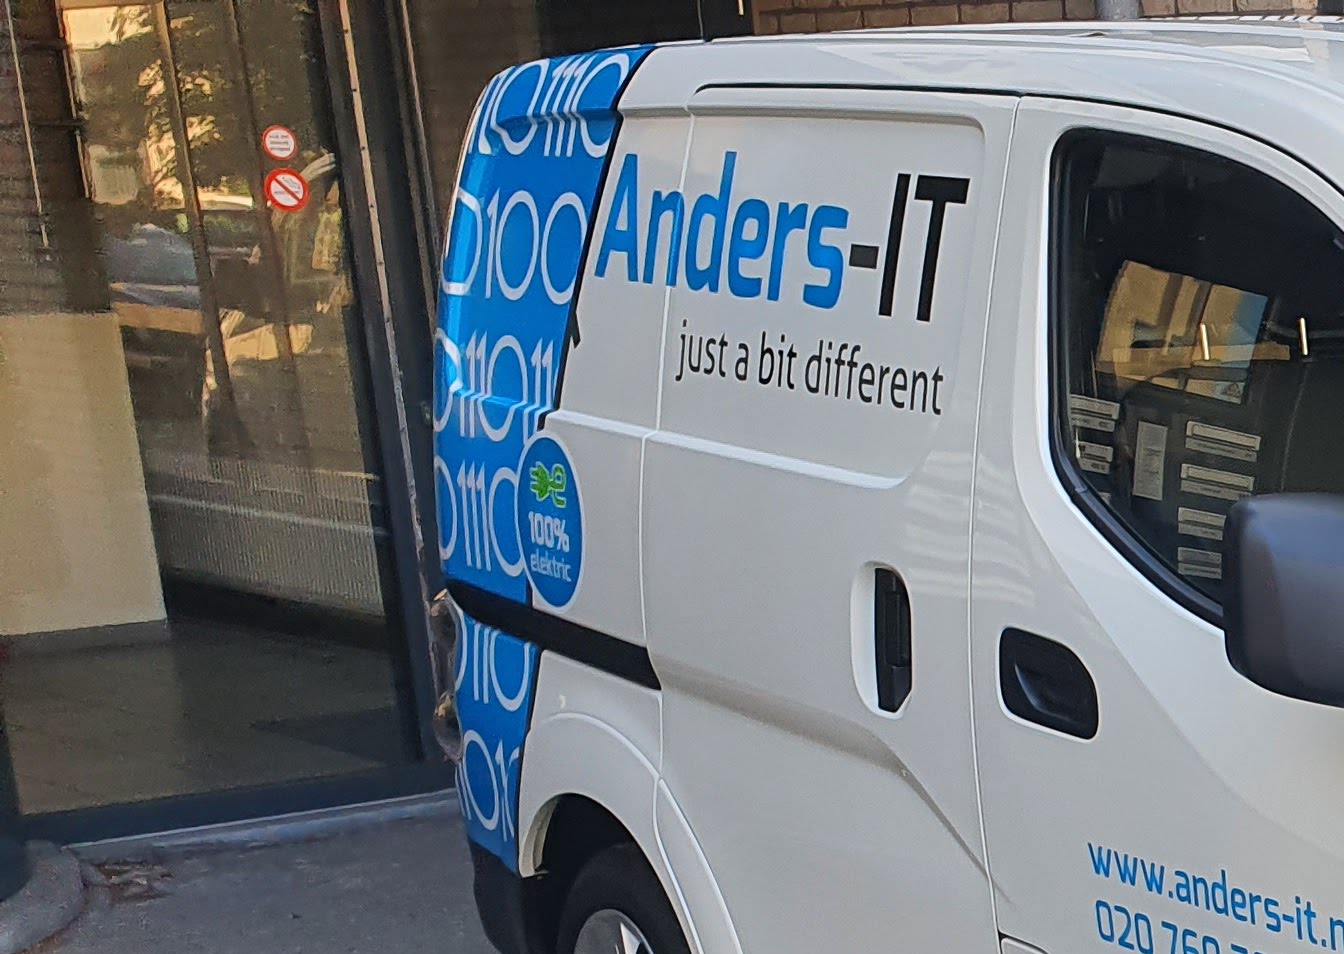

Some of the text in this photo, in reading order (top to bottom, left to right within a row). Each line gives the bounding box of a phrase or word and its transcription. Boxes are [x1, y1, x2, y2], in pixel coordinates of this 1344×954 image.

[594, 151, 971, 323] Anders-IT
[675, 319, 944, 416] just a bit different
[528, 511, 570, 553] 100%
[530, 551, 572, 583] elektric
